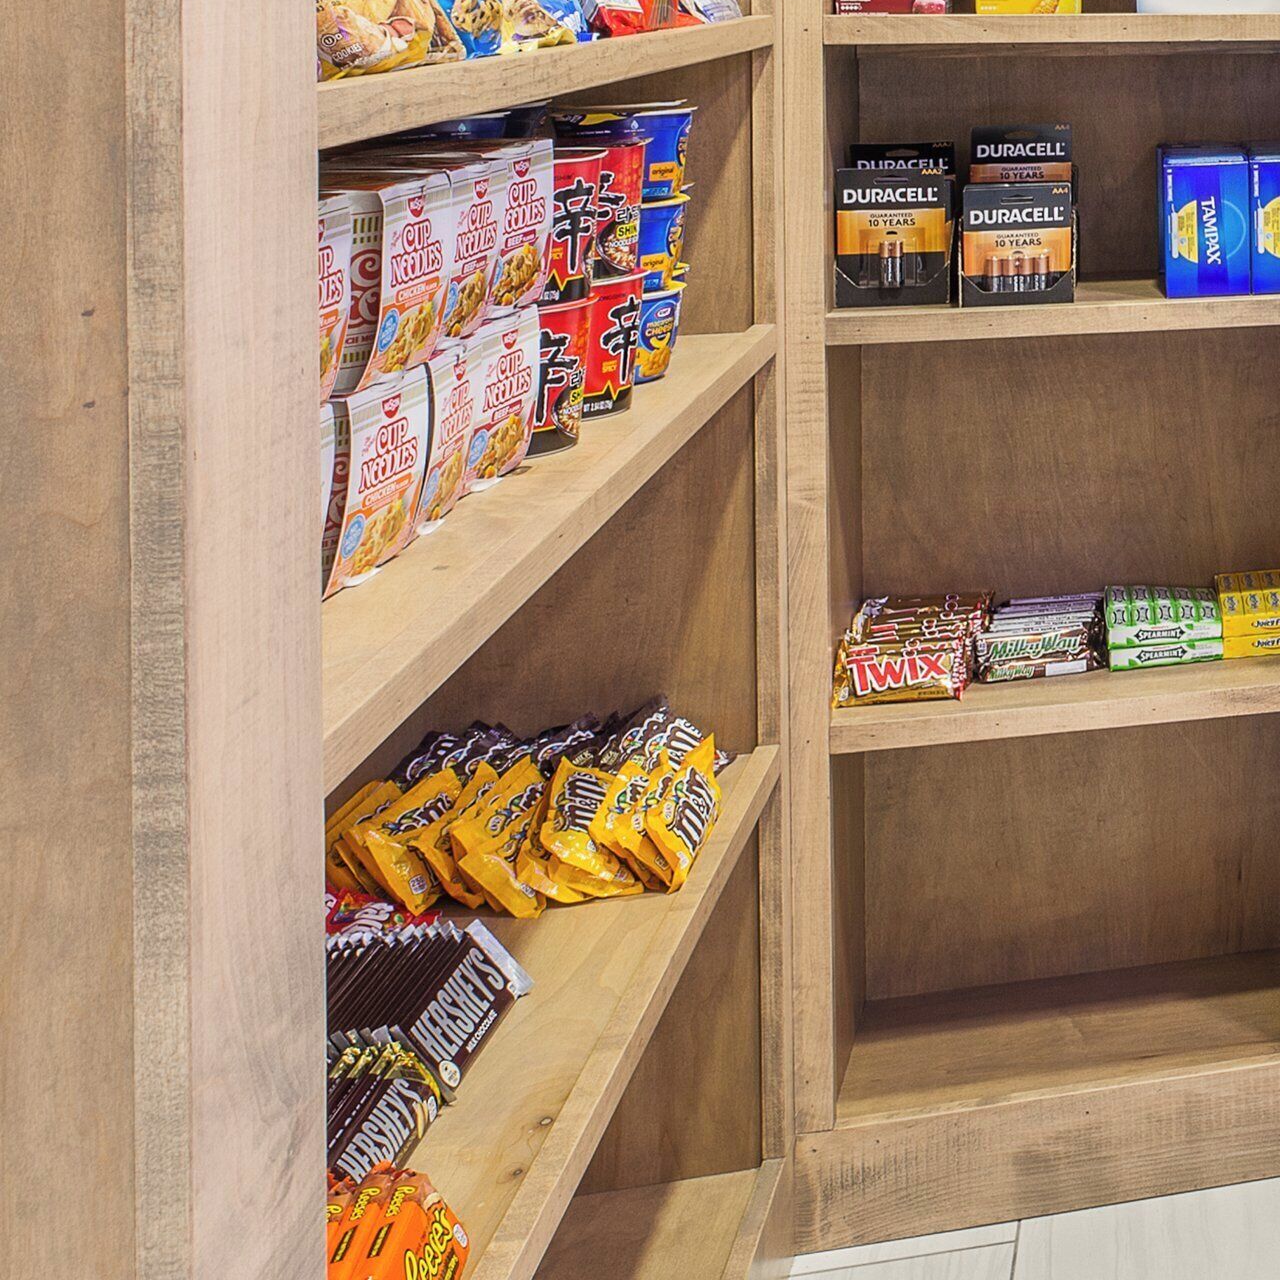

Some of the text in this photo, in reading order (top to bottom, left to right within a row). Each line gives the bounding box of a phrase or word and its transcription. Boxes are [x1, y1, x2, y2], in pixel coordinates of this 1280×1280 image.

[976, 142, 1065, 158] DURACELL
[999, 171, 1045, 180] 10 YEARS
[508, 179, 537, 210] CUP
[843, 187, 938, 204] DURACELL
[468, 200, 493, 231] CUP
[868, 218, 916, 227] 10 YEARS
[969, 206, 1064, 225] DURACELL
[1201, 196, 1222, 265] TAMPAX
[402, 219, 431, 254] CUP
[455, 221, 498, 262] NOODLES
[995, 238, 1042, 248] 10 YEARS
[391, 241, 443, 288] NOODLES
[496, 349, 524, 381] CUP
[483, 366, 532, 413] NOODLES
[375, 417, 409, 457] CUP
[358, 437, 418, 494] NOODLES
[1138, 628, 1182, 639] SPEARMINT
[1253, 620, 1274, 629] Juicy
[1140, 647, 1184, 660] SPEARMINT
[1254, 639, 1275, 648] Juicy
[410, 947, 506, 1061] HERSHEY'S
